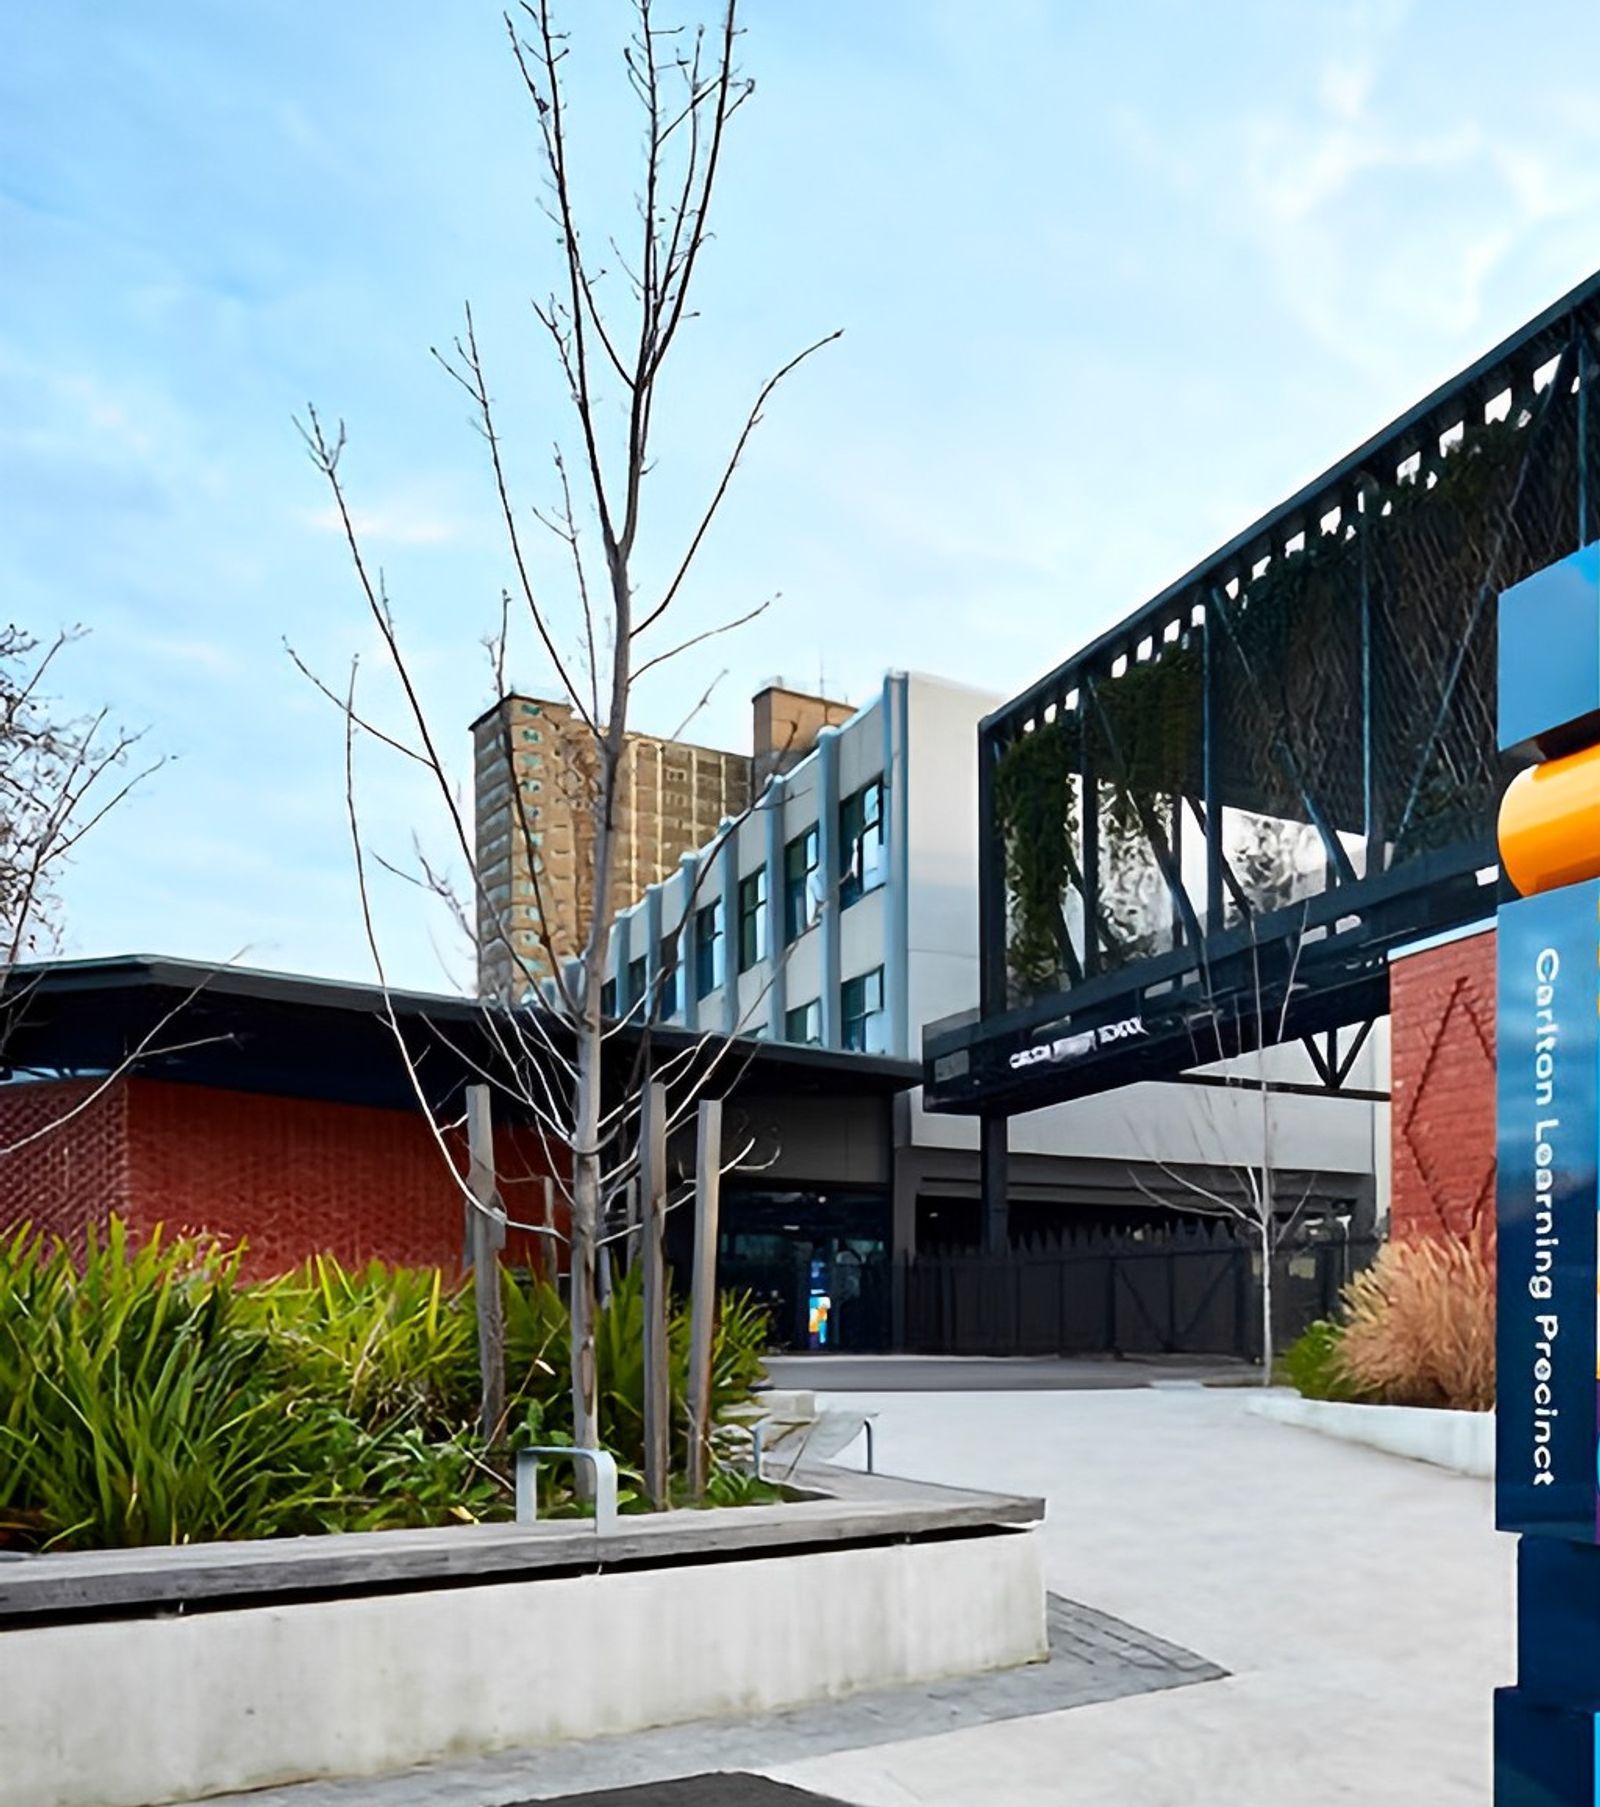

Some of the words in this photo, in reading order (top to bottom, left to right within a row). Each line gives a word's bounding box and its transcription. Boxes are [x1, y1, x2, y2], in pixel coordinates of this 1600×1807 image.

[1534, 947, 1560, 1106] Carlton
[1528, 1118, 1559, 1299] Learning
[1533, 1314, 1559, 1485] Precinct
